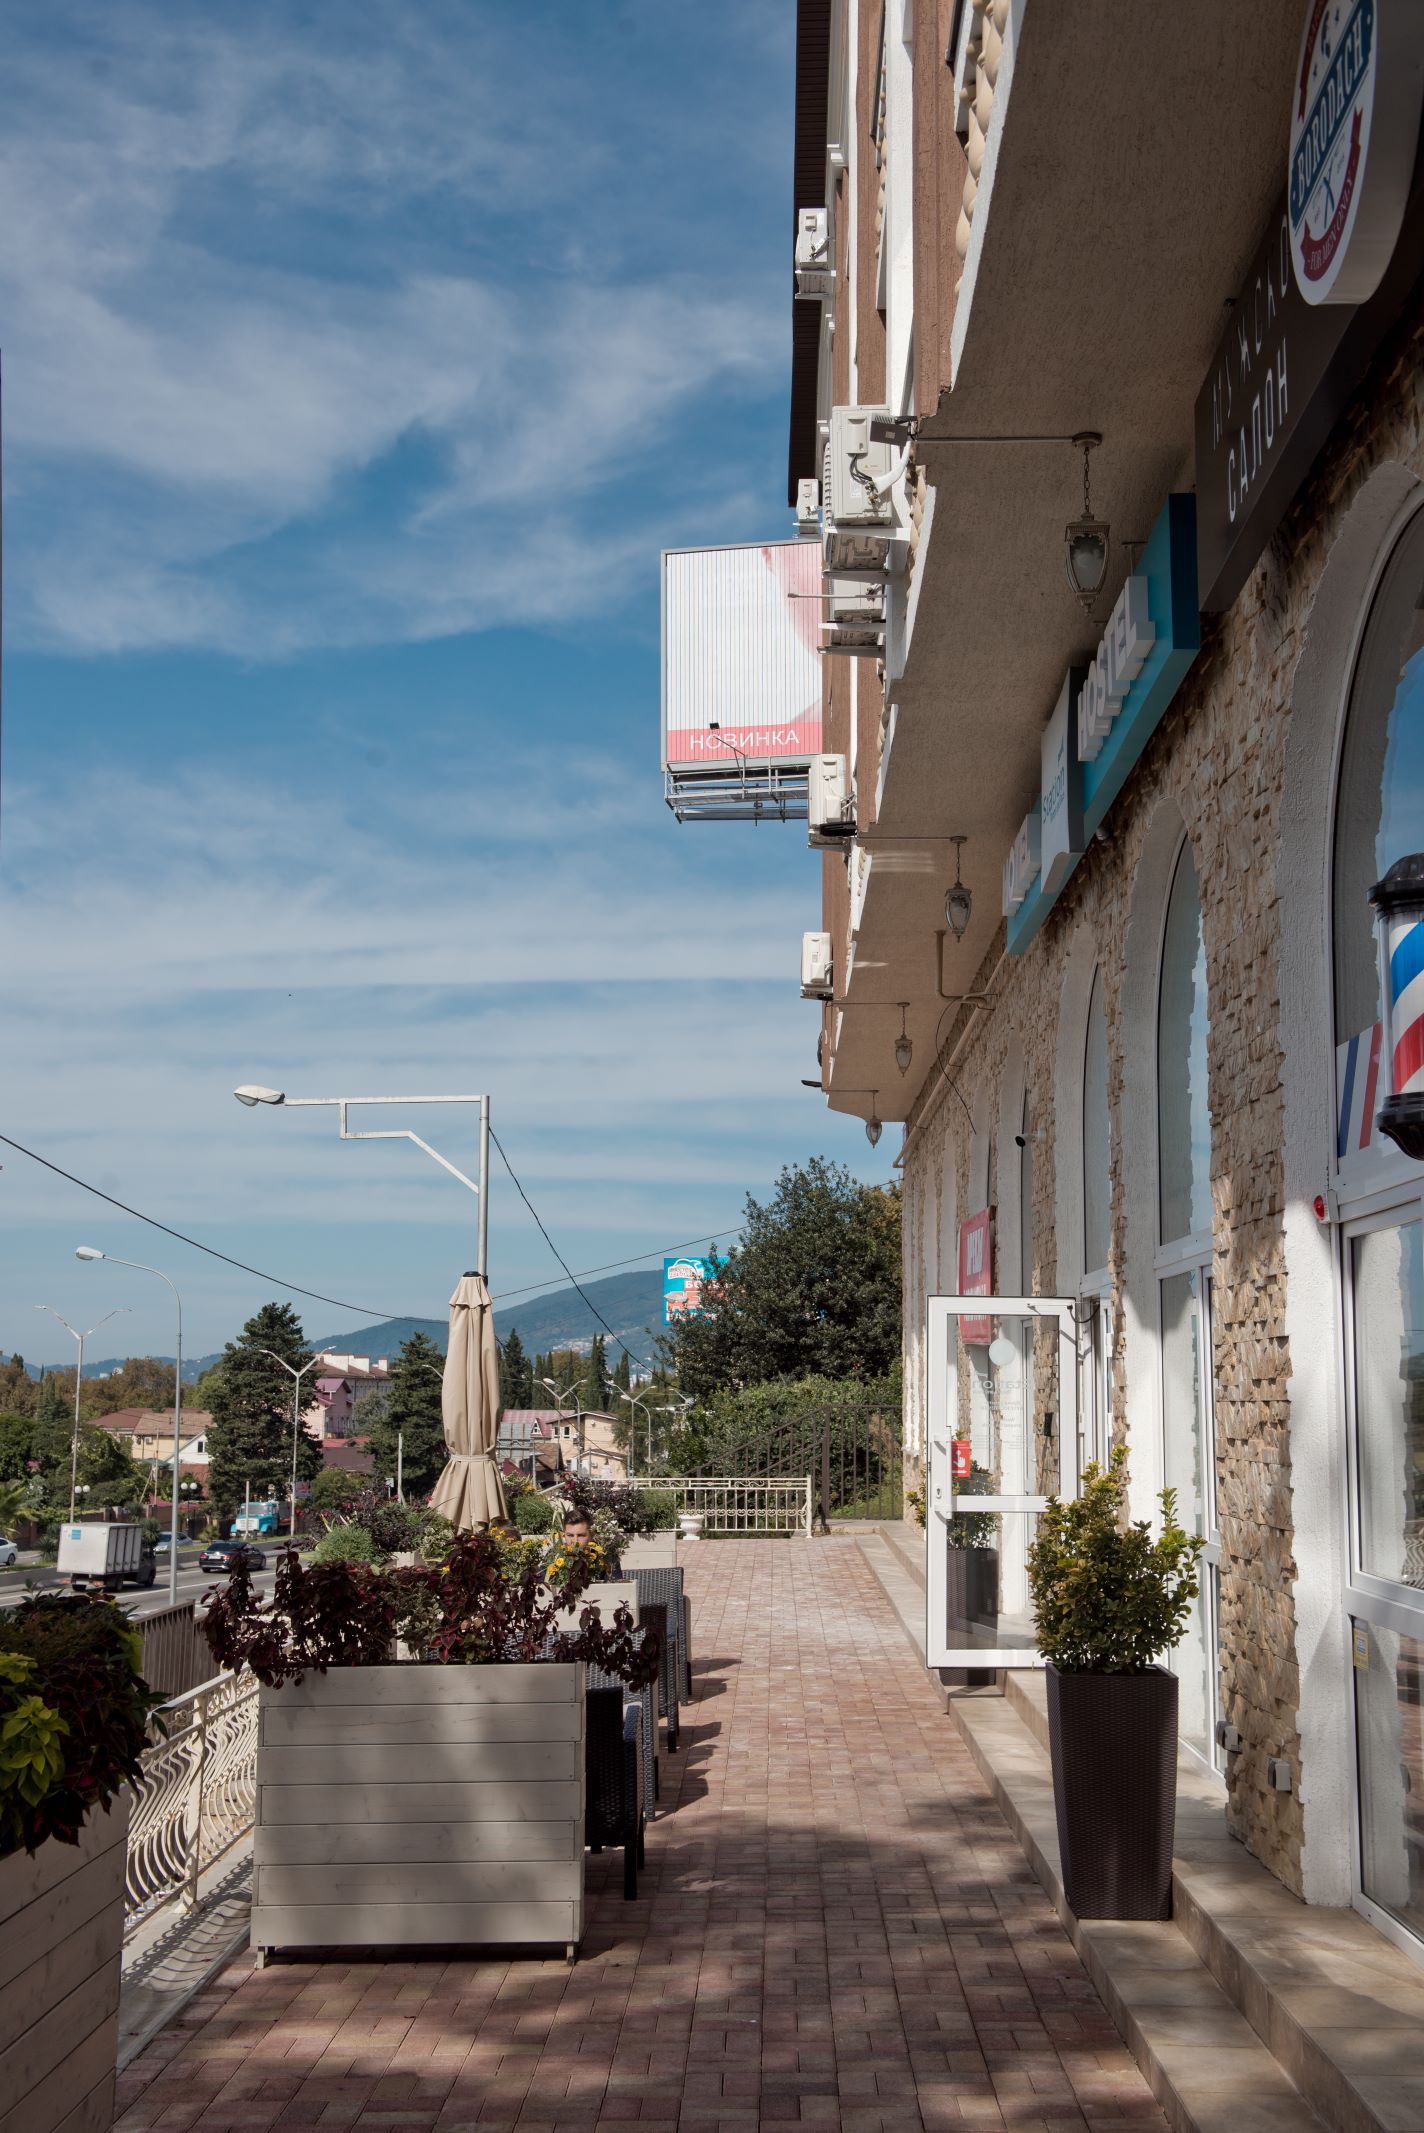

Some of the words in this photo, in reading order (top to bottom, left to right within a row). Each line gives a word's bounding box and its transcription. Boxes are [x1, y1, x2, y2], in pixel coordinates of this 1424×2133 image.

[1298, 8, 1364, 208] BORODACH
[1212, 213, 1290, 450] МУЖСКО
[1310, 247, 1323, 271] FOR
[1321, 224, 1338, 264] MEN
[1228, 336, 1289, 523] САЛОН
[689, 729, 800, 750] НОВИНКА
[1078, 576, 1153, 762] HOSTEL
[1043, 767, 1065, 824] Station
